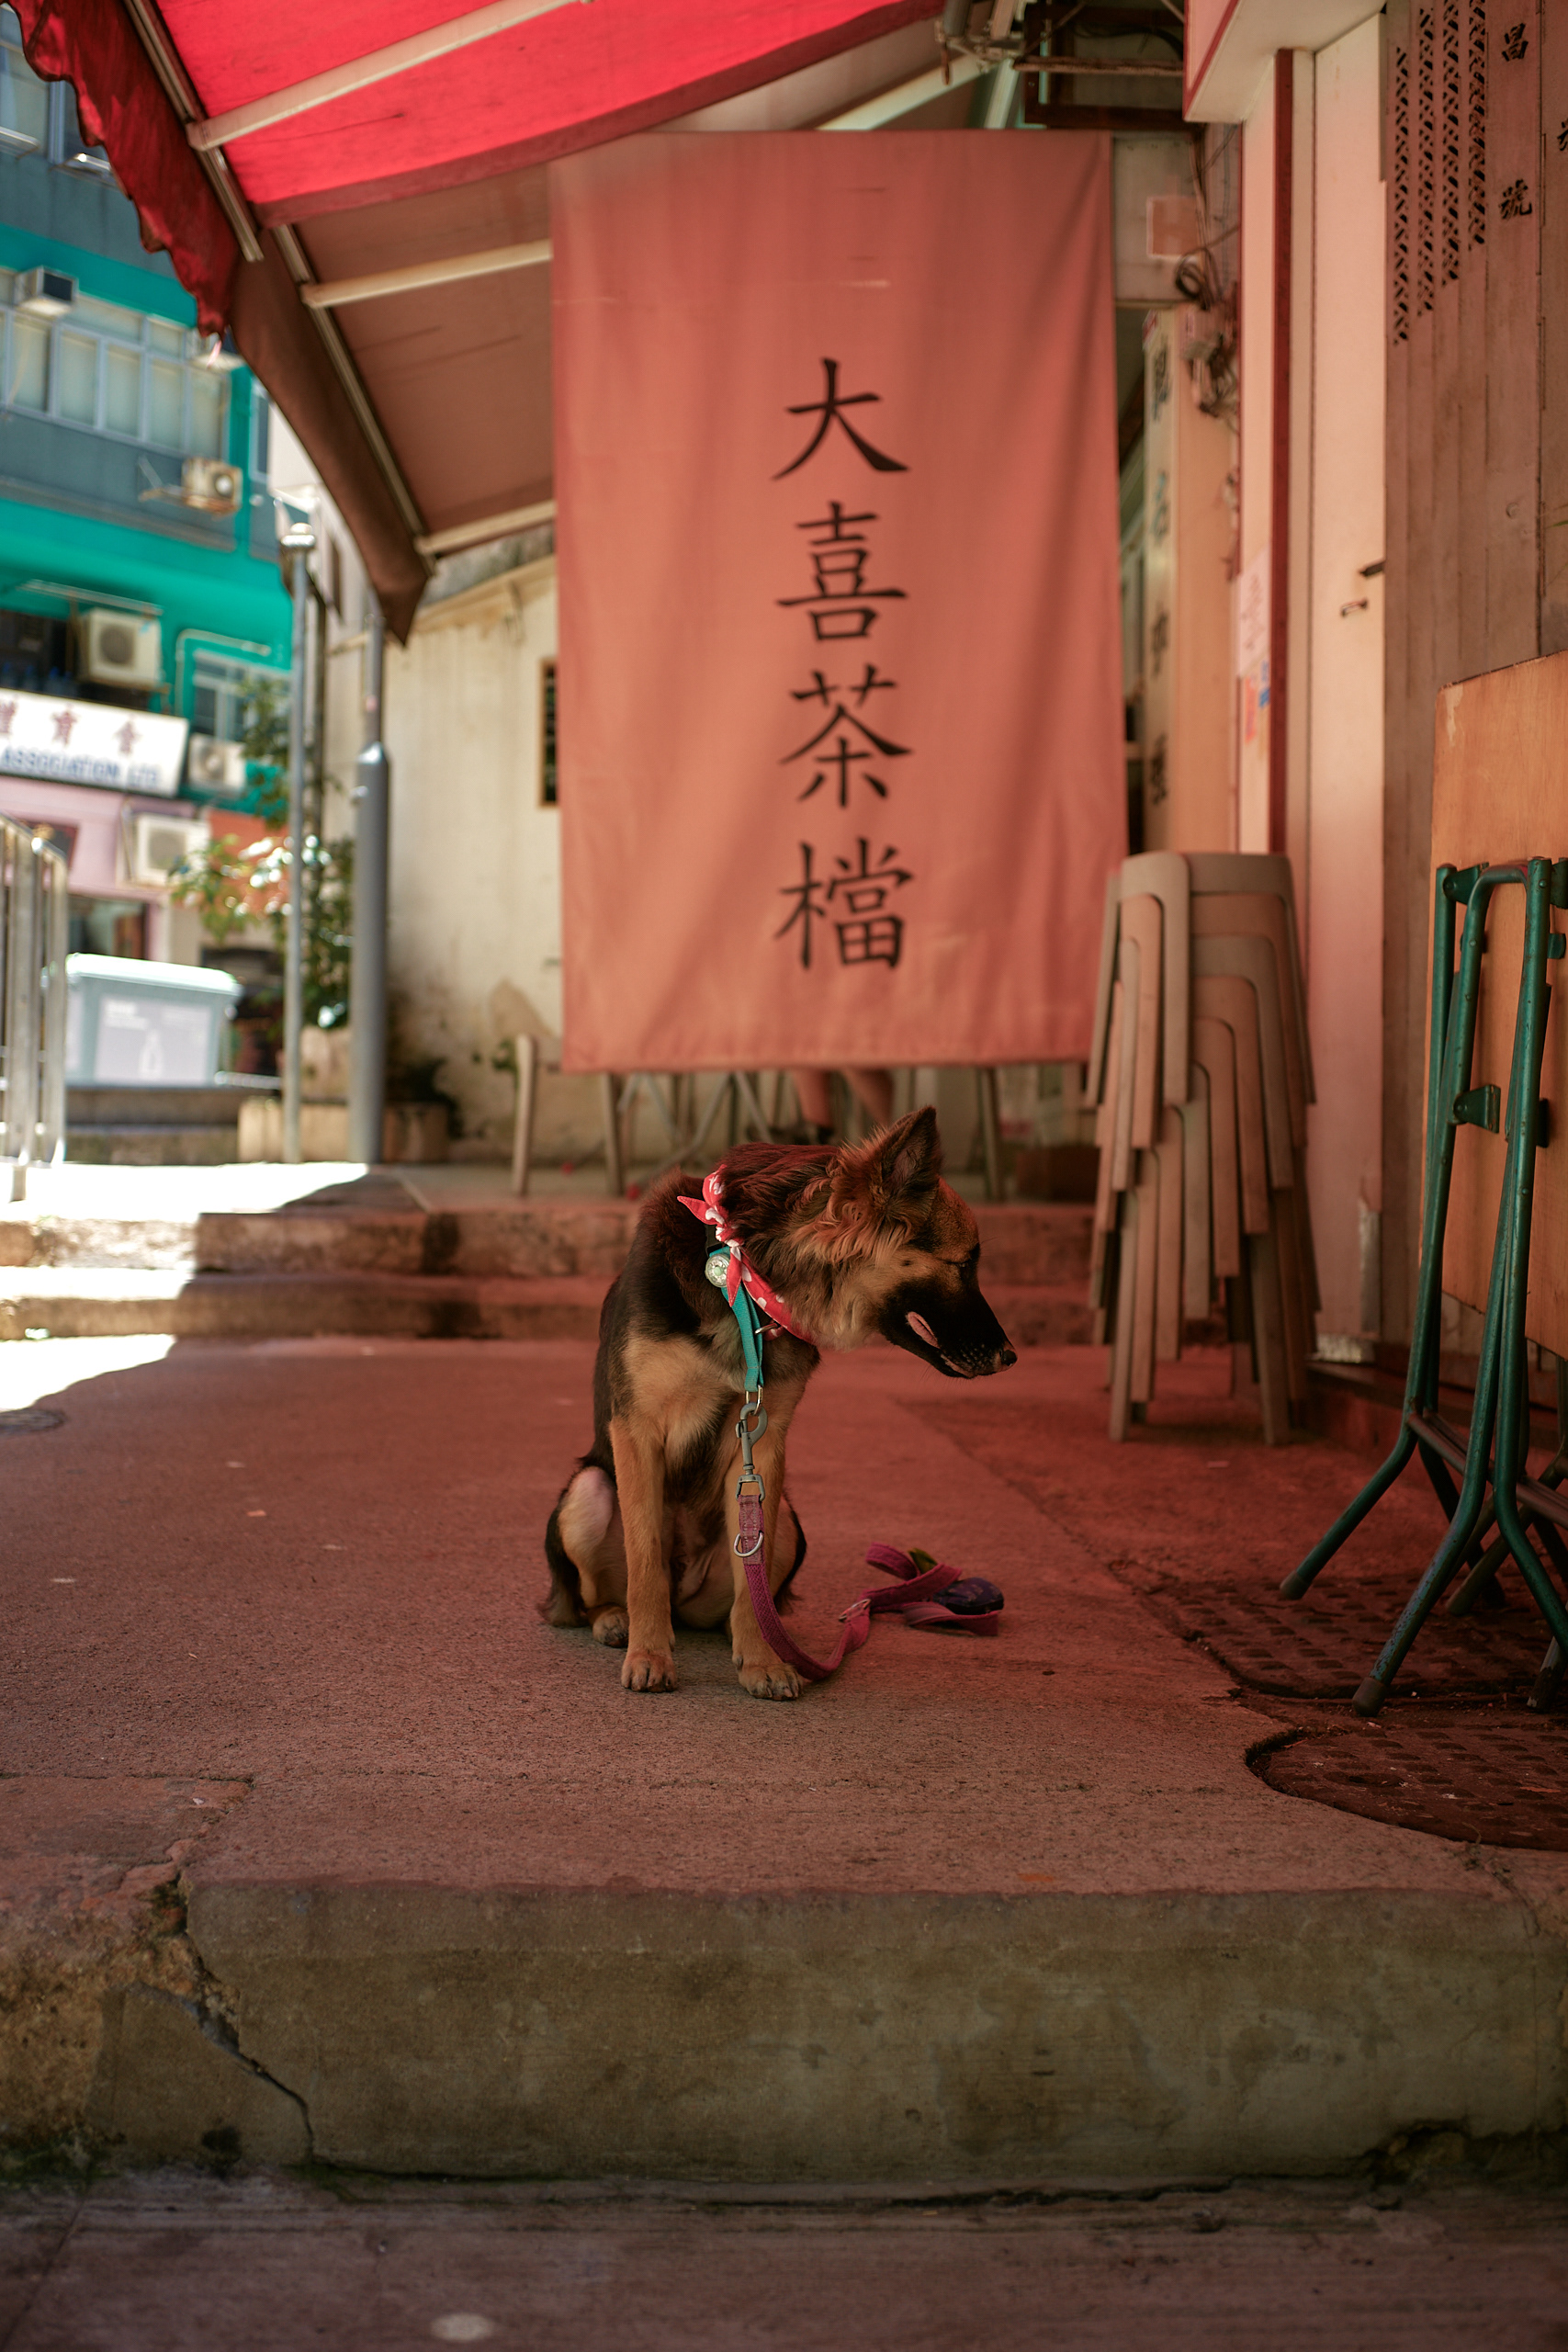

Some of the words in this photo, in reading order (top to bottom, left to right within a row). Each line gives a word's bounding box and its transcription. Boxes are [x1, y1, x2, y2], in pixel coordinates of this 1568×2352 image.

[1, 746, 121, 782] ASSOCIATION
[772, 356, 913, 972] 大喜茶檔
